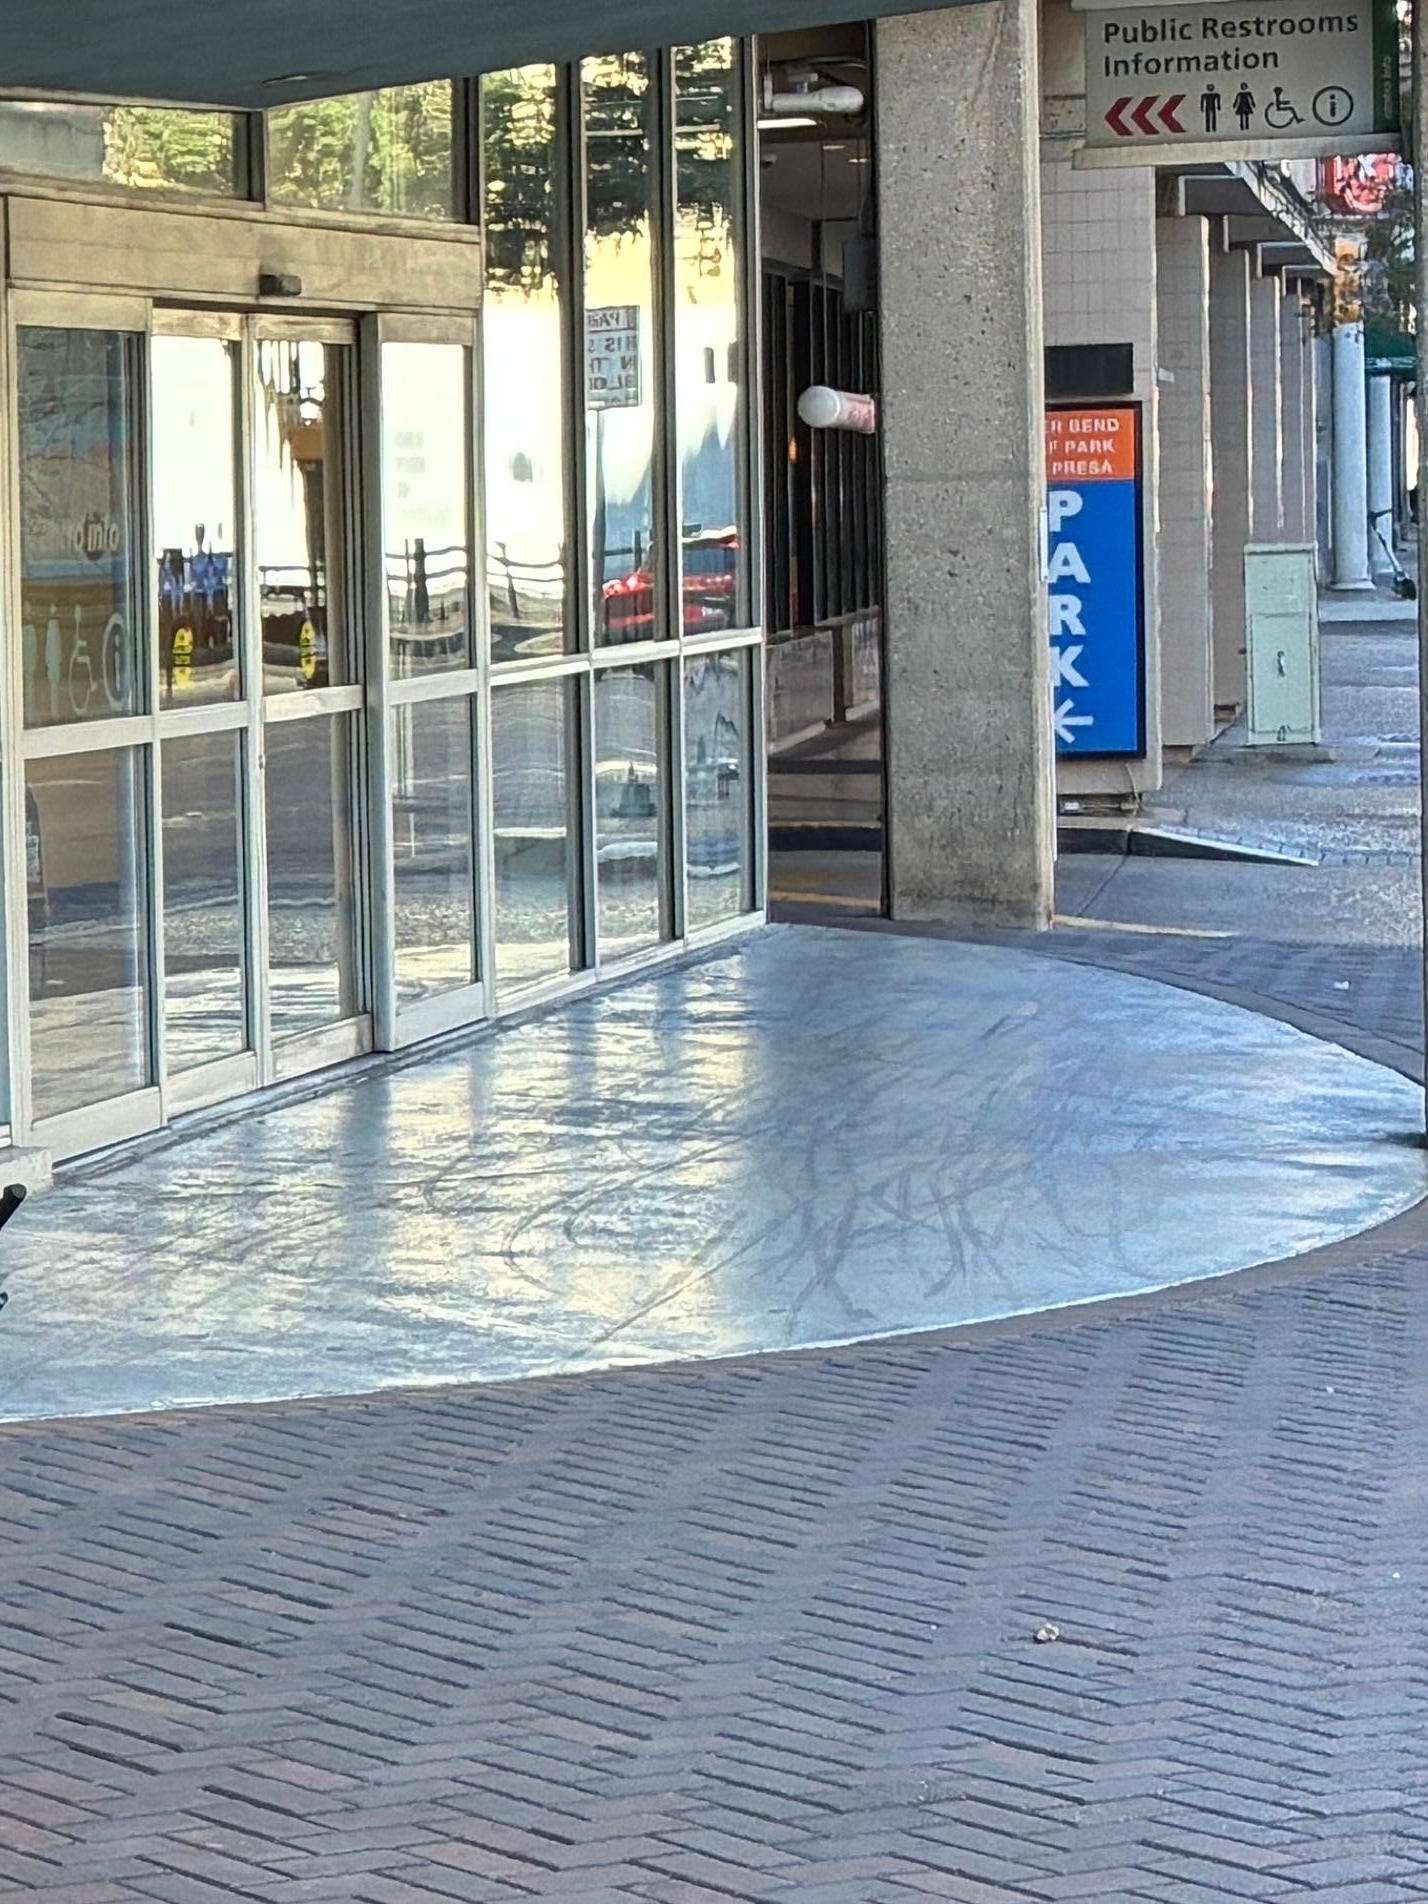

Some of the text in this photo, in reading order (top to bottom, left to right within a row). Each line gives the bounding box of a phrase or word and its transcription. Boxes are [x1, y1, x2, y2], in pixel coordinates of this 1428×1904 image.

[1103, 12, 1359, 44] Public Restrooms
[1103, 47, 1279, 77] Information
[1069, 418, 1120, 433] BEND
[1065, 439, 1116, 454] PARK
[1052, 460, 1113, 475] PRESA
[1048, 490, 1092, 687] PARK
